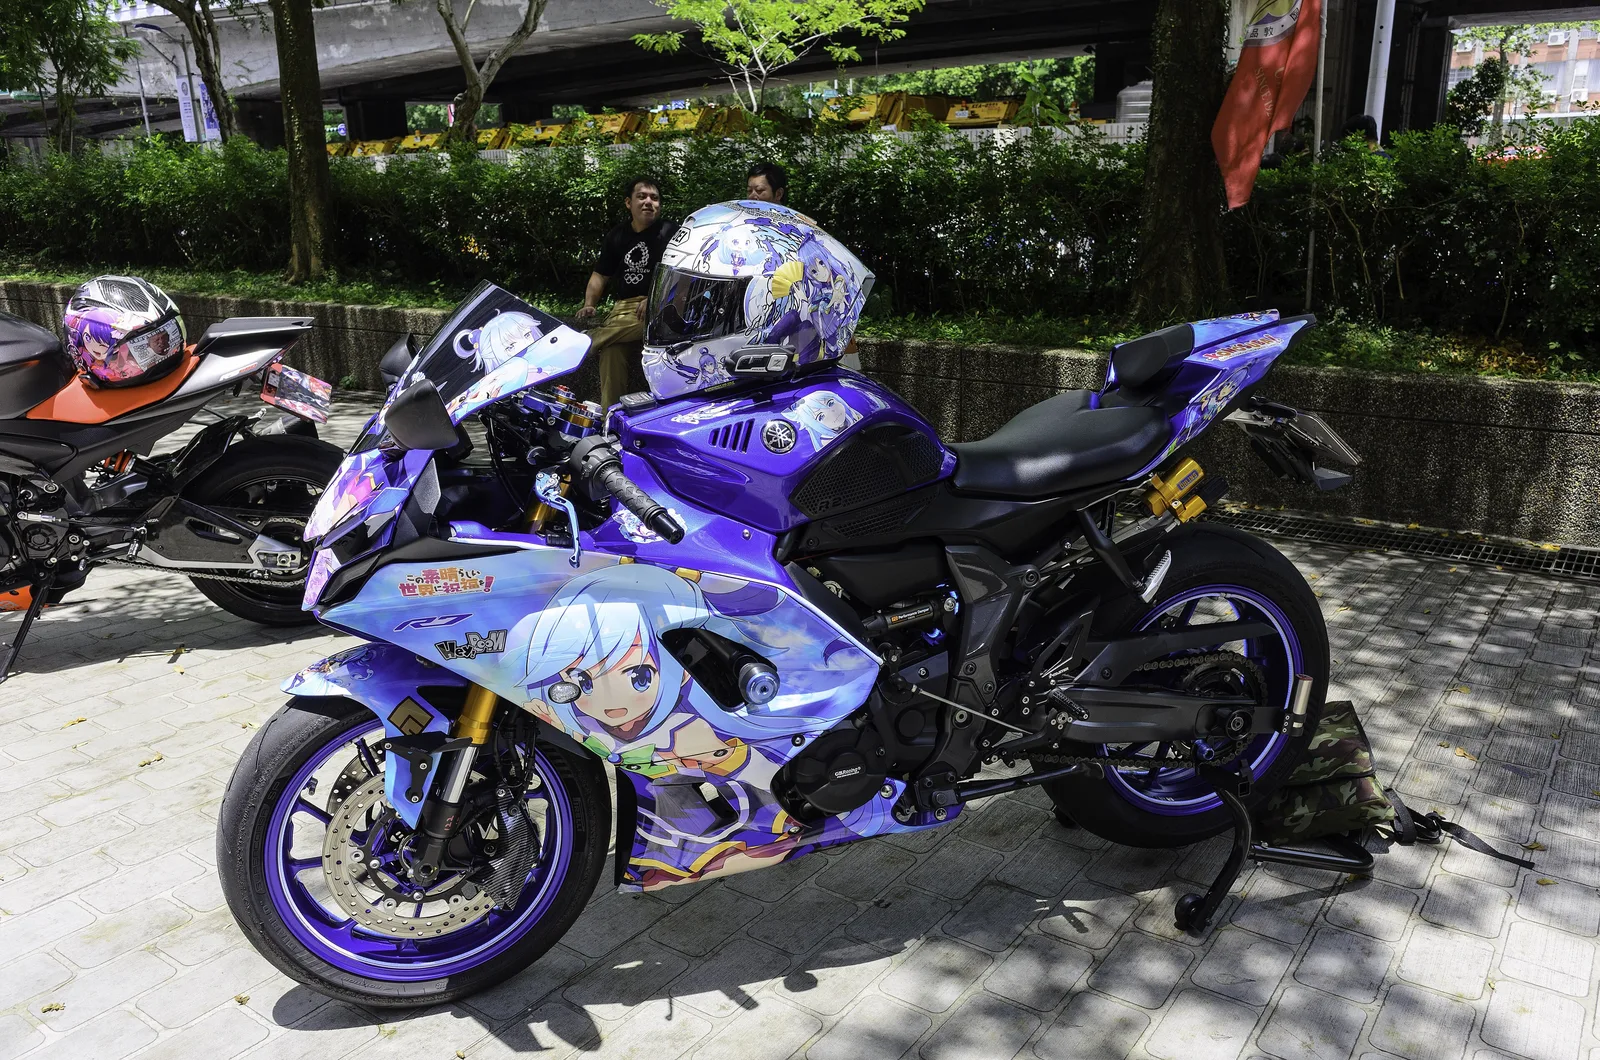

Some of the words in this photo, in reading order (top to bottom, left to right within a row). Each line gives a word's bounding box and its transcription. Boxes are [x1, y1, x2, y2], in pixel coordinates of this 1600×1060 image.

[407, 567, 481, 584] この素晴らしい
